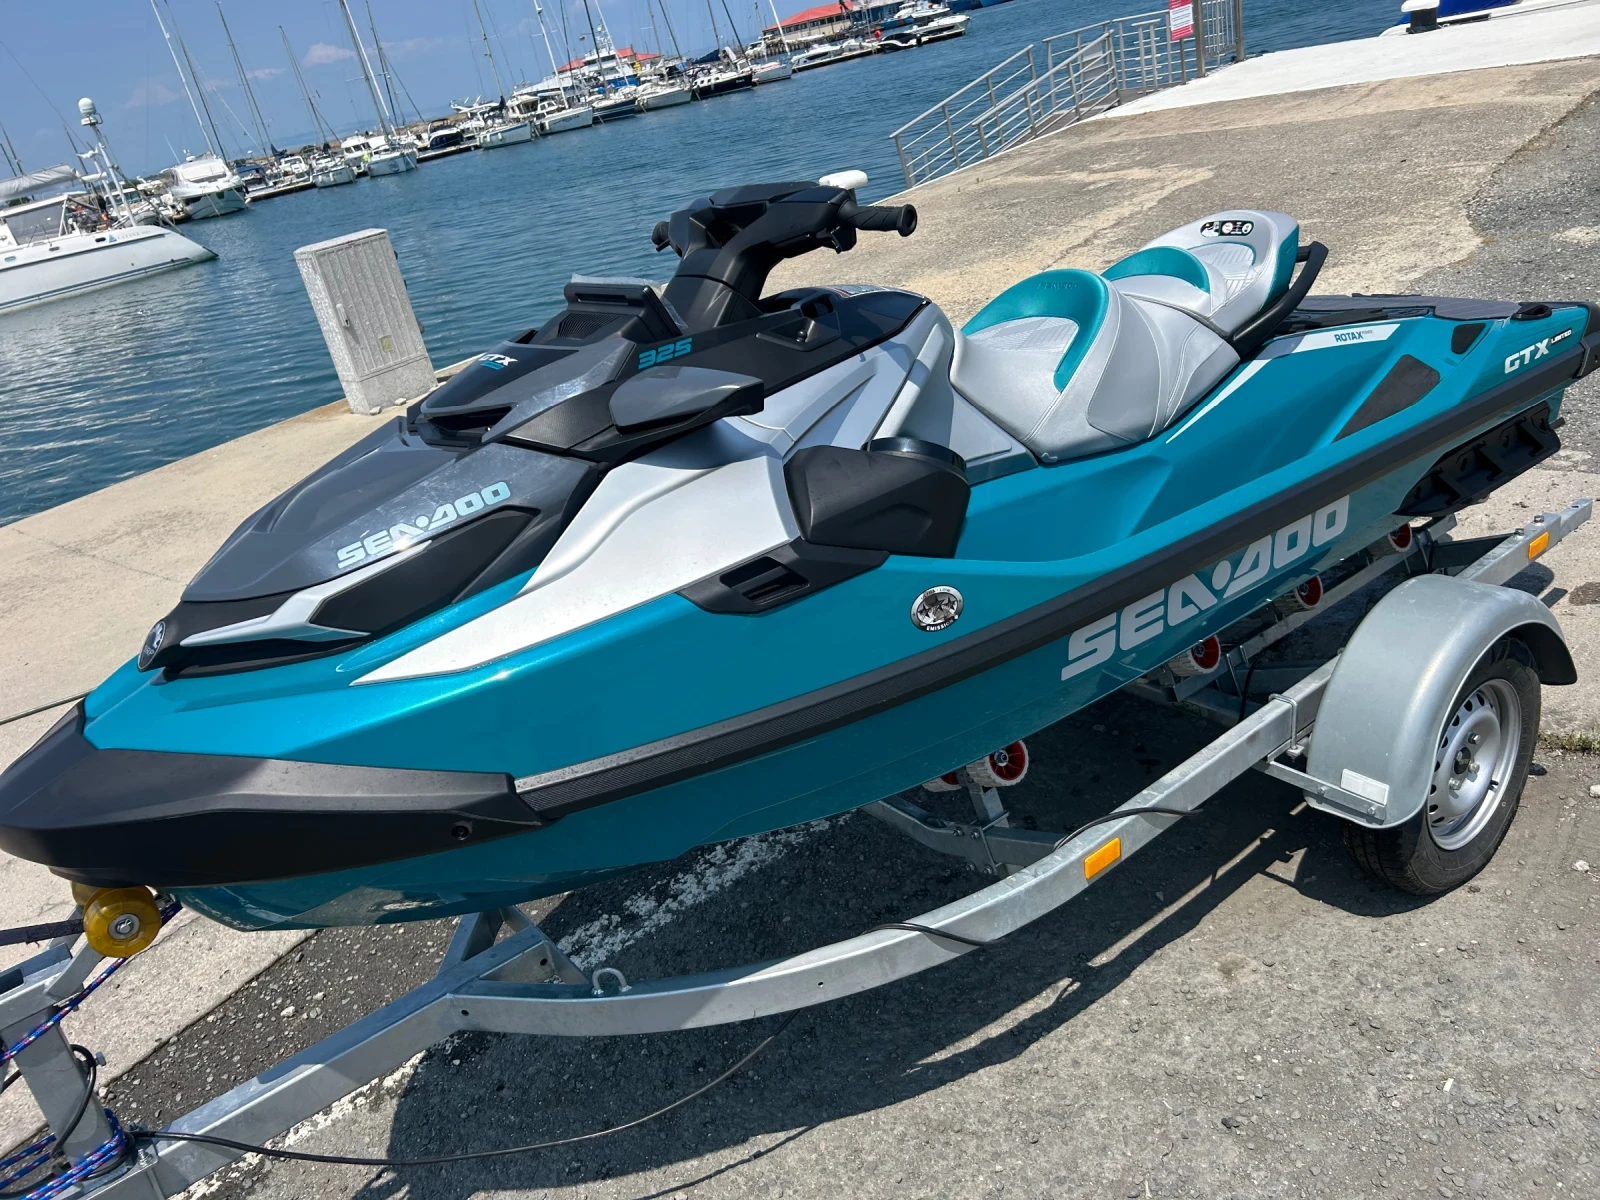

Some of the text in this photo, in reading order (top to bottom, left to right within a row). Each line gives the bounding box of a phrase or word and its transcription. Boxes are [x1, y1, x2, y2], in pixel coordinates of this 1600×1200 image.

[1333, 331, 1364, 343] ROTAX
[478, 353, 519, 367] GTX
[637, 337, 693, 370] 325
[1504, 338, 1549, 374] GTX
